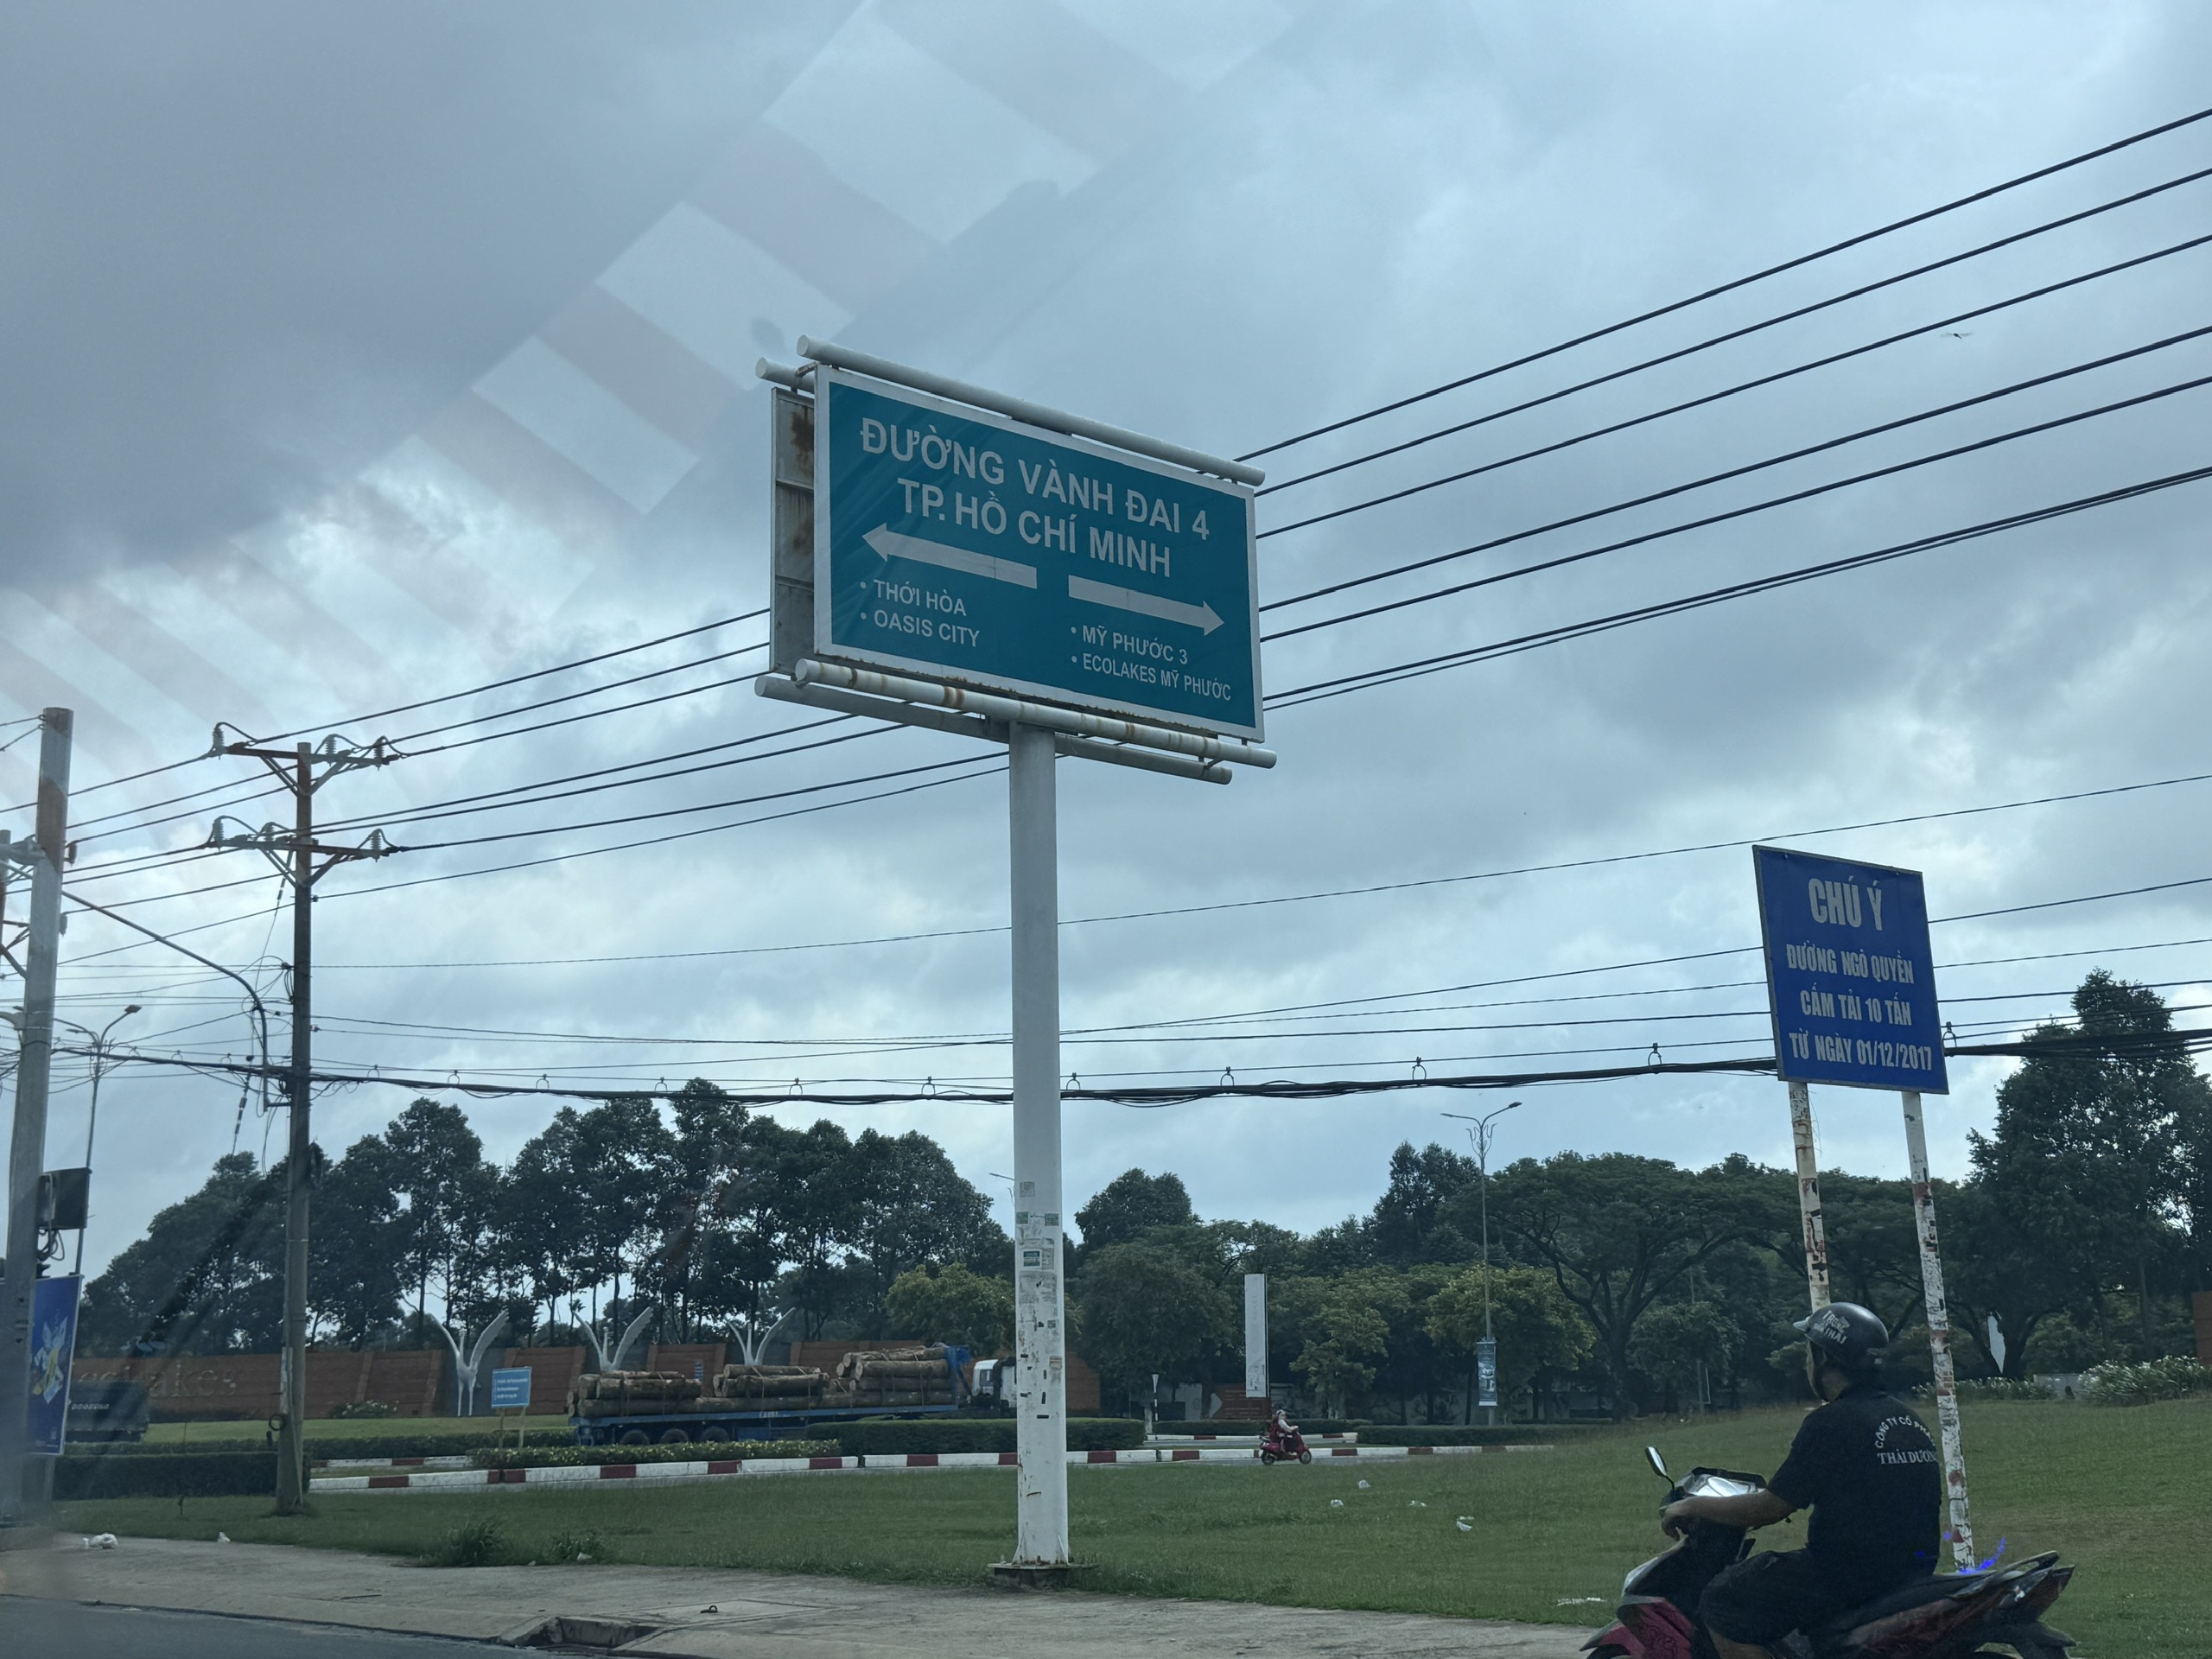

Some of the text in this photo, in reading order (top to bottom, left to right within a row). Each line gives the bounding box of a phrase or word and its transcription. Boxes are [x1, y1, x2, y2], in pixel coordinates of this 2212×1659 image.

[860, 416, 1210, 540] ĐƯỜNG VÀNH ĐAI 4
[1018, 513, 1077, 554] CHÍ
[1089, 525, 1171, 577] MINH
[873, 579, 967, 617] THỚI HÒA
[874, 608, 980, 647] OASIS CITY
[1082, 625, 1188, 665] MỸ PHƯỚC 3
[1083, 652, 1231, 702] ECOLAKES MỸ PHƯỚC
[1808, 875, 1883, 931] CHÚ Ý
[1786, 939, 1915, 985] ĐƯỜNG NGÔ QUYỀN
[1800, 982, 1913, 1027] CẤM TẢI 10 TẤN
[1789, 1027, 1933, 1071] TỪ NGÀY 01/12/2017
[1874, 1421, 1890, 1449] CÔNG
[1886, 1417, 1898, 1427] TY
[1877, 1448, 1908, 1465] THÁI
